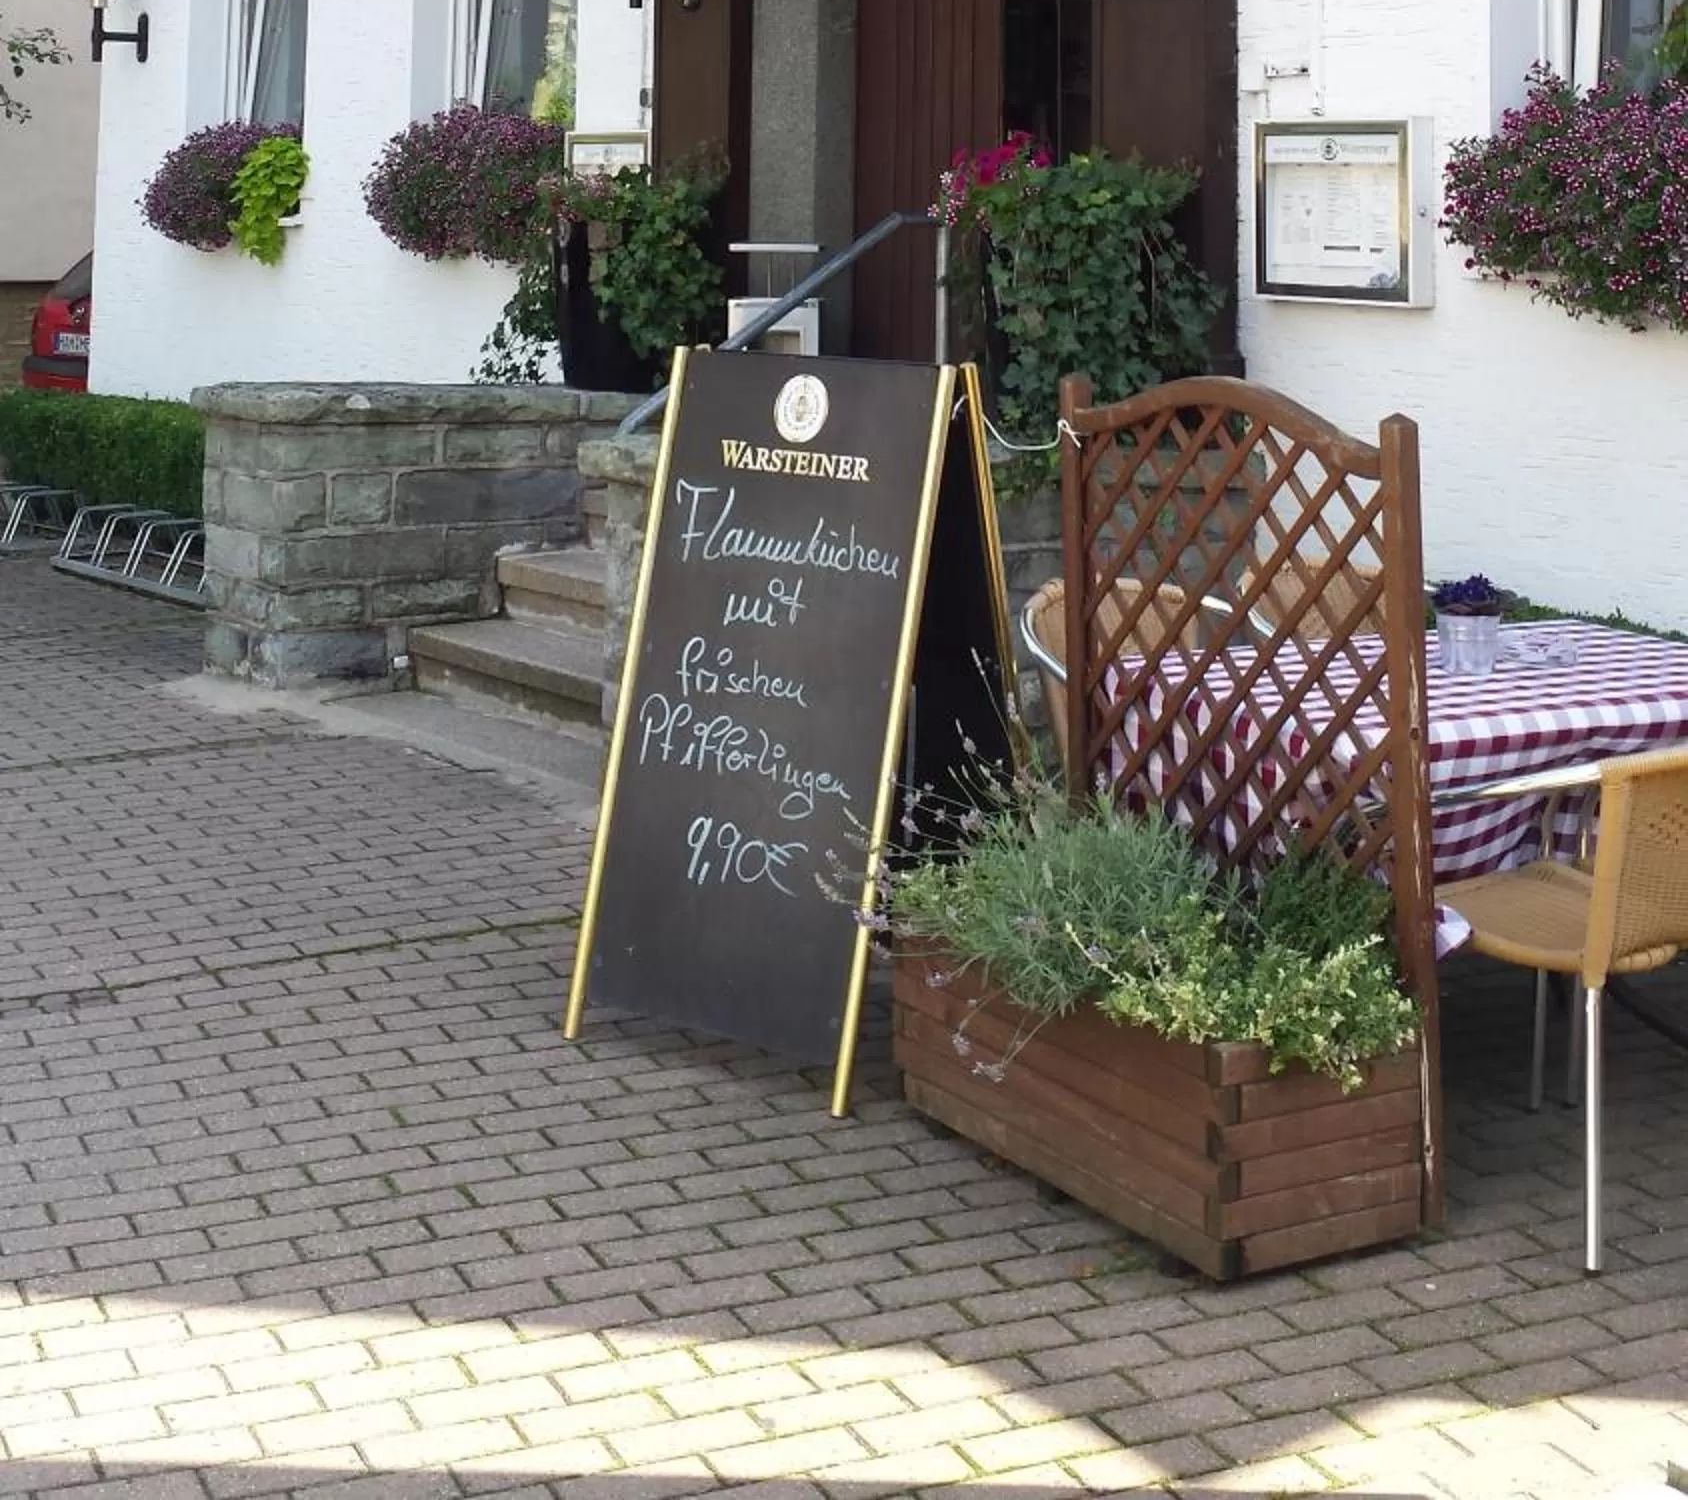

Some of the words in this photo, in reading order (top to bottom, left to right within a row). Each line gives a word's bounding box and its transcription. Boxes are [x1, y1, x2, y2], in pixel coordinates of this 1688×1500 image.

[720, 438, 870, 482] WARSTEINER
[723, 578, 807, 627] mit
[675, 636, 811, 708] frischen
[639, 692, 852, 820] Pfifferlingen
